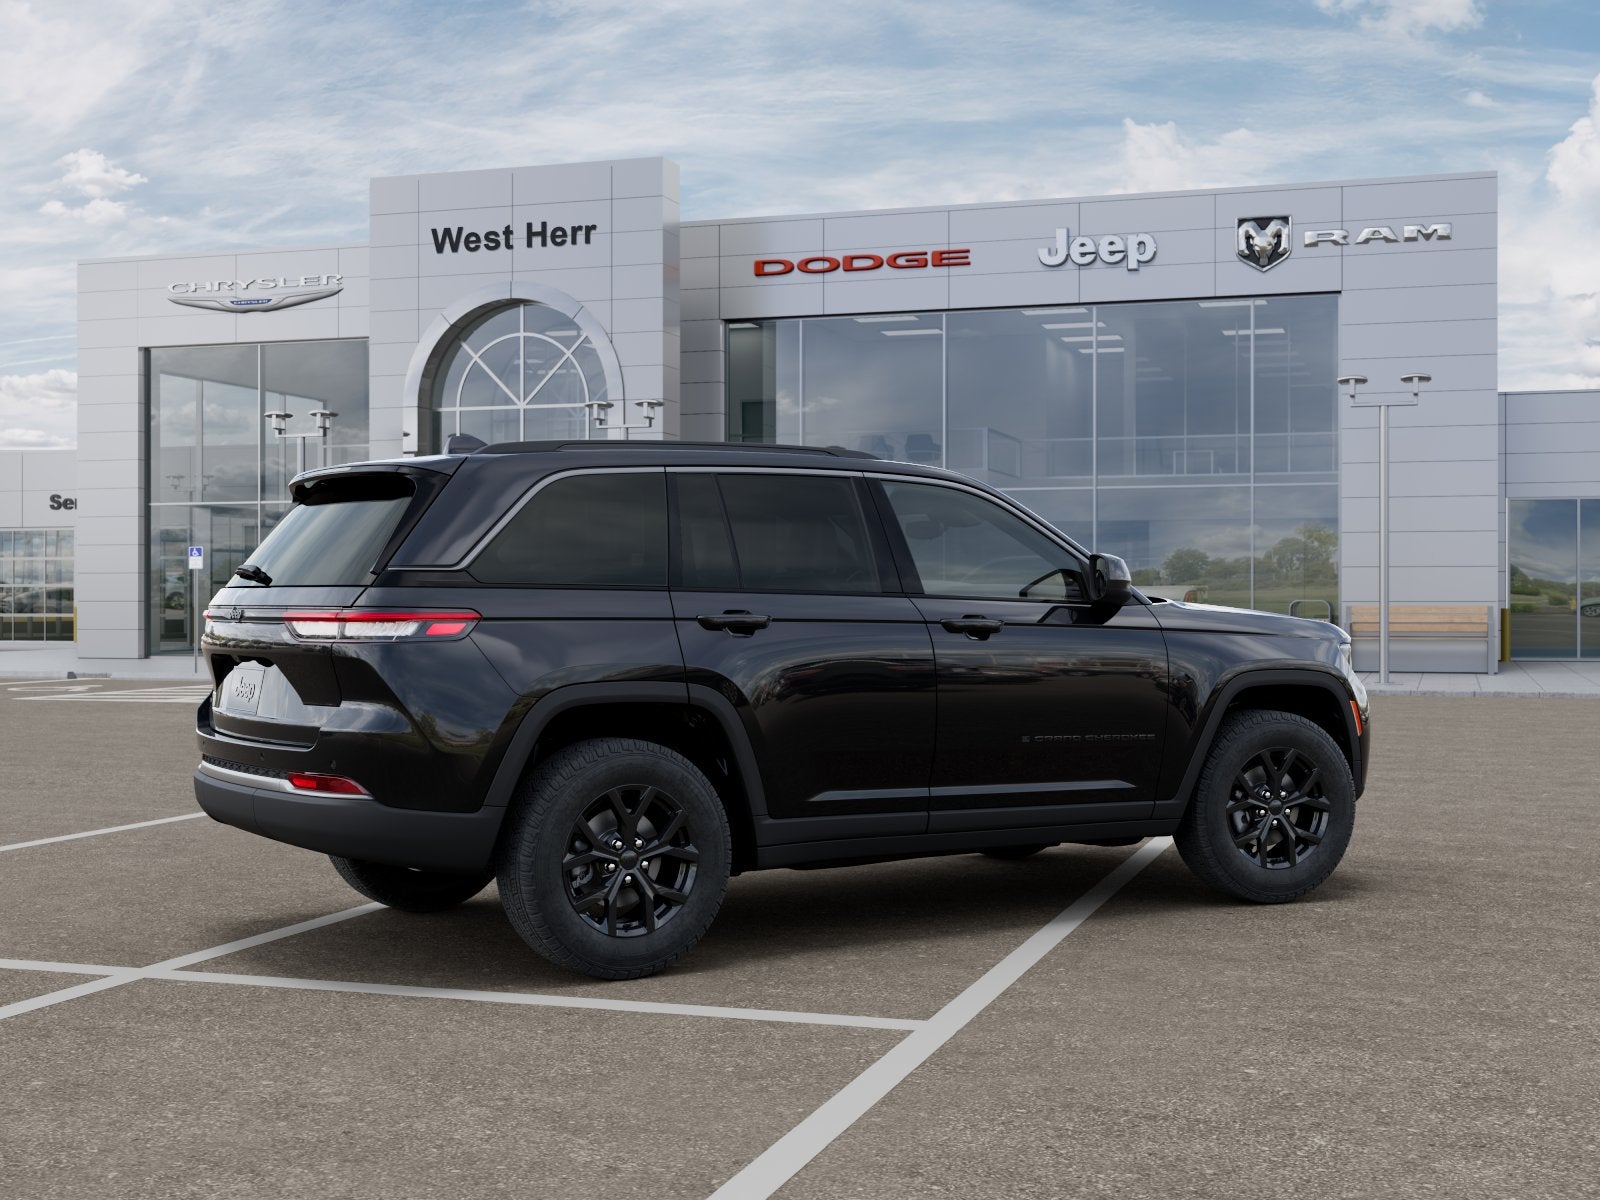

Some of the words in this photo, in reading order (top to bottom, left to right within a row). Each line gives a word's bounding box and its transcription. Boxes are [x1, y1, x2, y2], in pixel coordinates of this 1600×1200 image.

[431, 224, 514, 254] West
[526, 221, 597, 248] Herr
[1037, 227, 1157, 272] Jeep
[1304, 222, 1452, 248] RAM
[753, 248, 971, 277] DODGE
[167, 273, 344, 294] CHRYSLER
